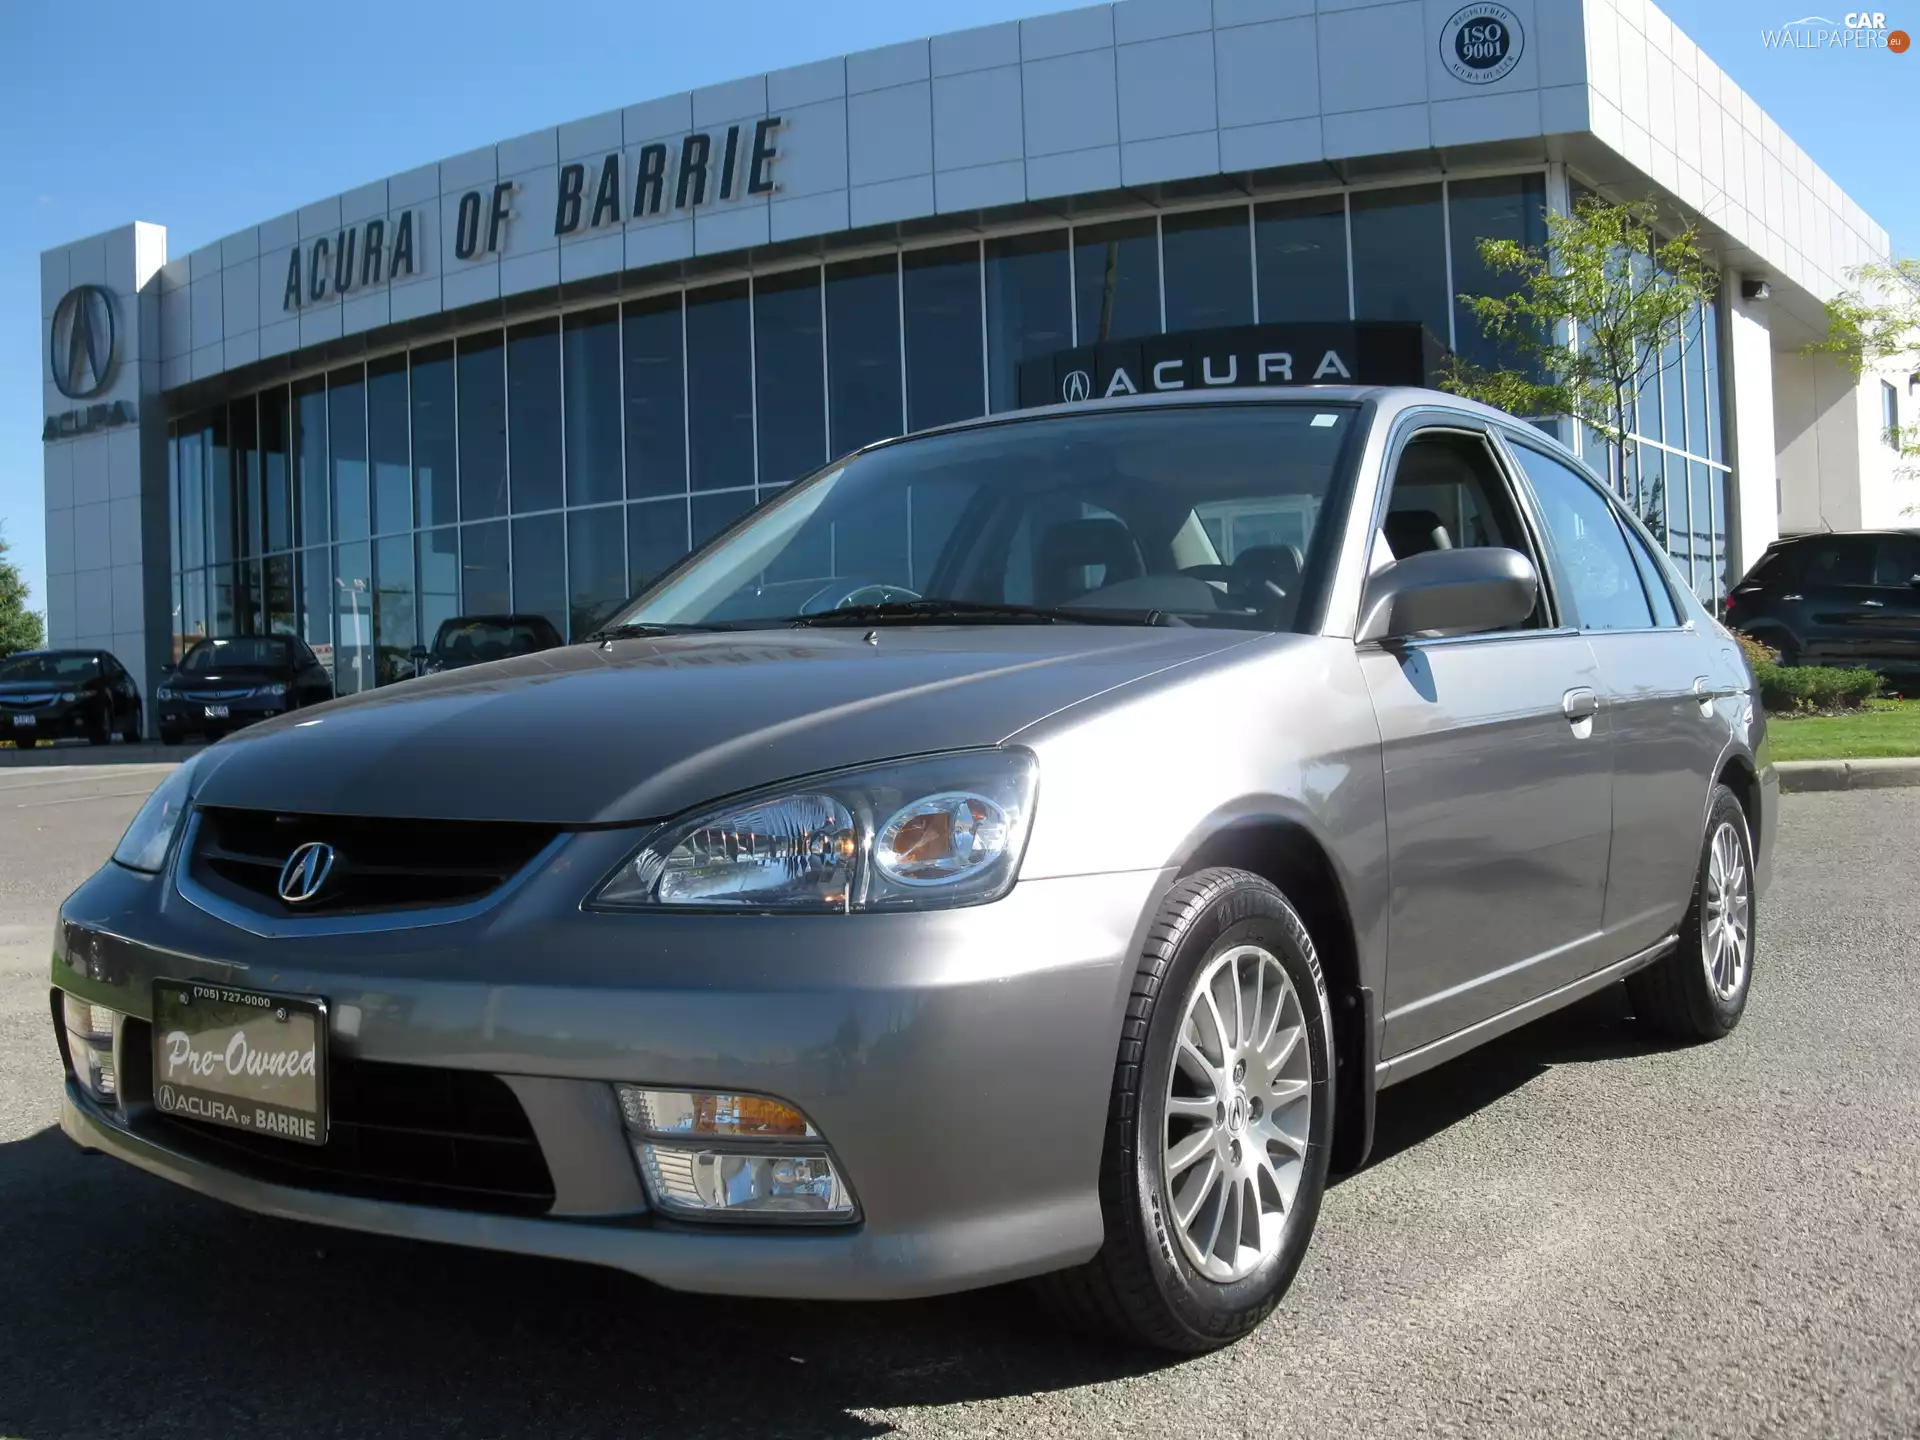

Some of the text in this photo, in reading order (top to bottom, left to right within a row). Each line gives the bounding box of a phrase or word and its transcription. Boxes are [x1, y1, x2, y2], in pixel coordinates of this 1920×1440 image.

[1462, 23, 1502, 45] ISO
[1462, 40, 1503, 61] 9001
[283, 116, 785, 312] ACURA OF BARRIE
[1104, 349, 1351, 399] ACURA
[193, 986, 271, 1008] (705) 727-0000
[166, 1030, 316, 1078] Pre-Owned
[175, 1094, 239, 1123] ACURA
[255, 1108, 316, 1140] BARRIE
